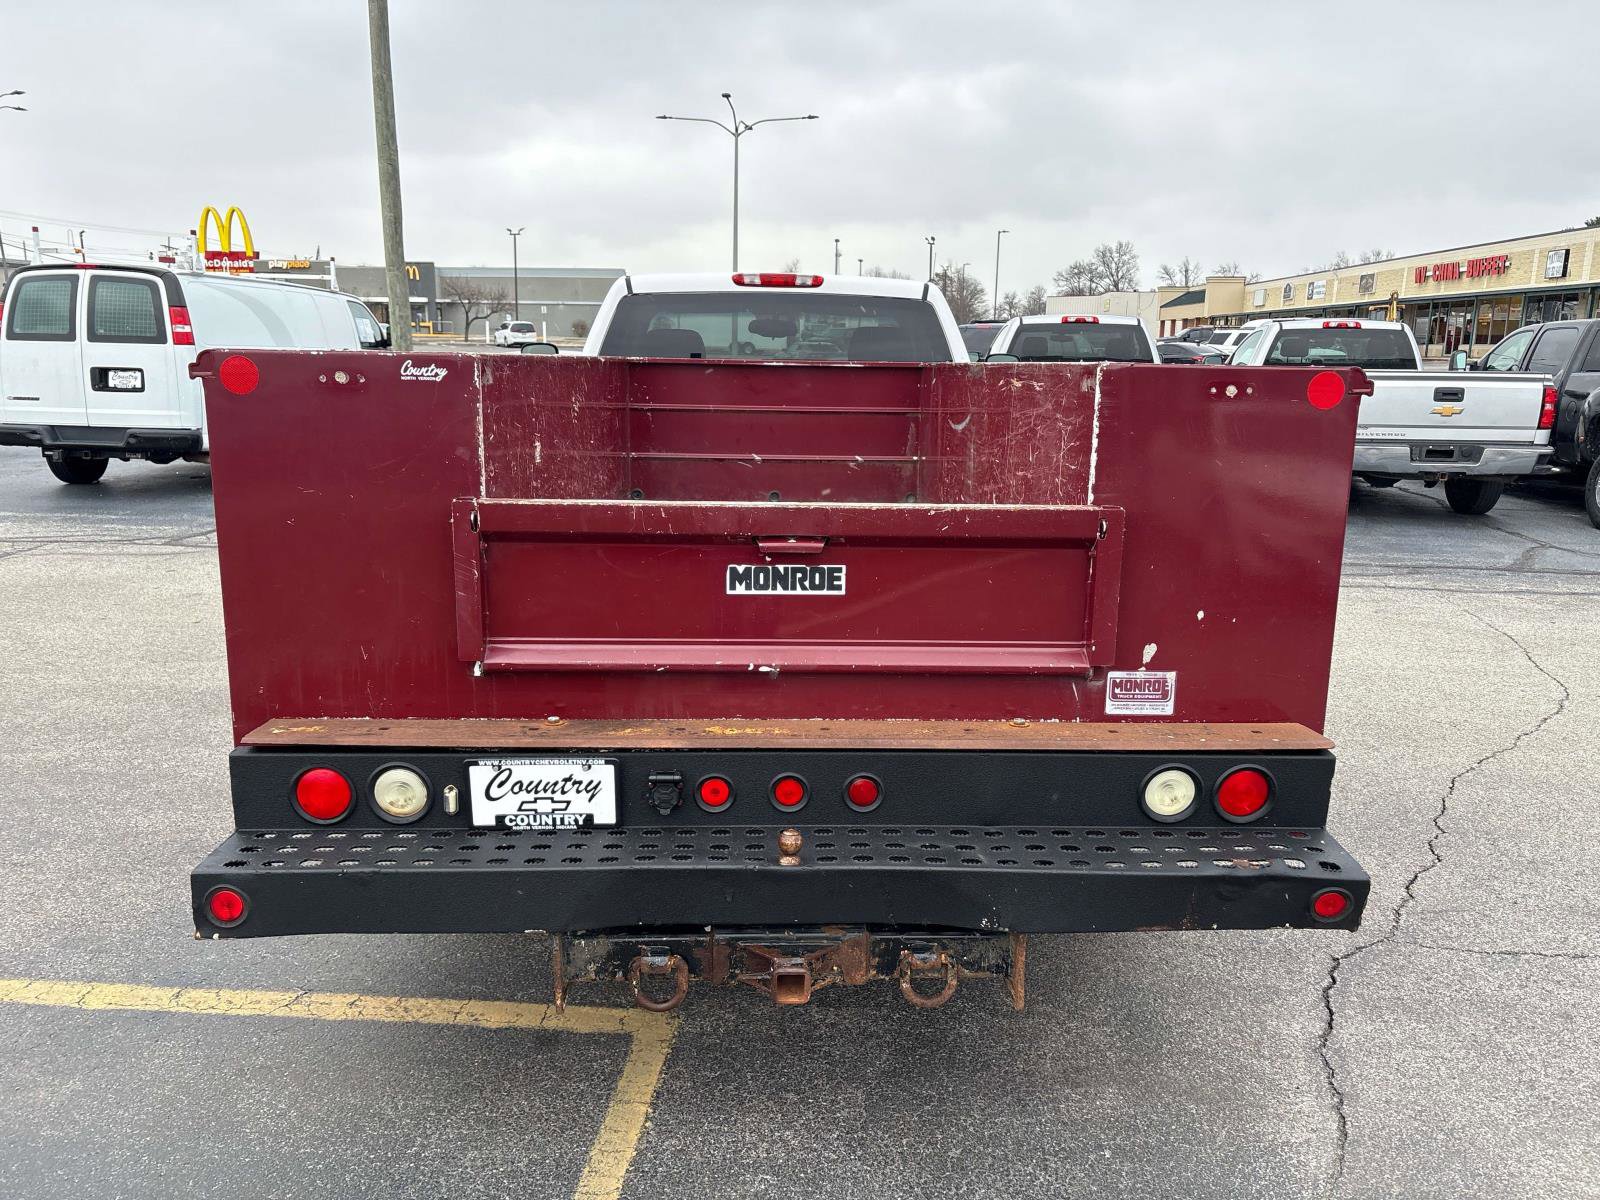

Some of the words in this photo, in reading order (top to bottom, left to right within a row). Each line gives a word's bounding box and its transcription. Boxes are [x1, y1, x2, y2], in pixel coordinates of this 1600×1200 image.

[1432, 262, 1460, 282] CHINA
[1466, 254, 1509, 278] BUFFET
[400, 359, 448, 382] Country
[729, 566, 843, 591] MONROE
[1112, 680, 1169, 692] MONROE
[484, 768, 603, 803] Country
[504, 814, 587, 827] COUNTRY
